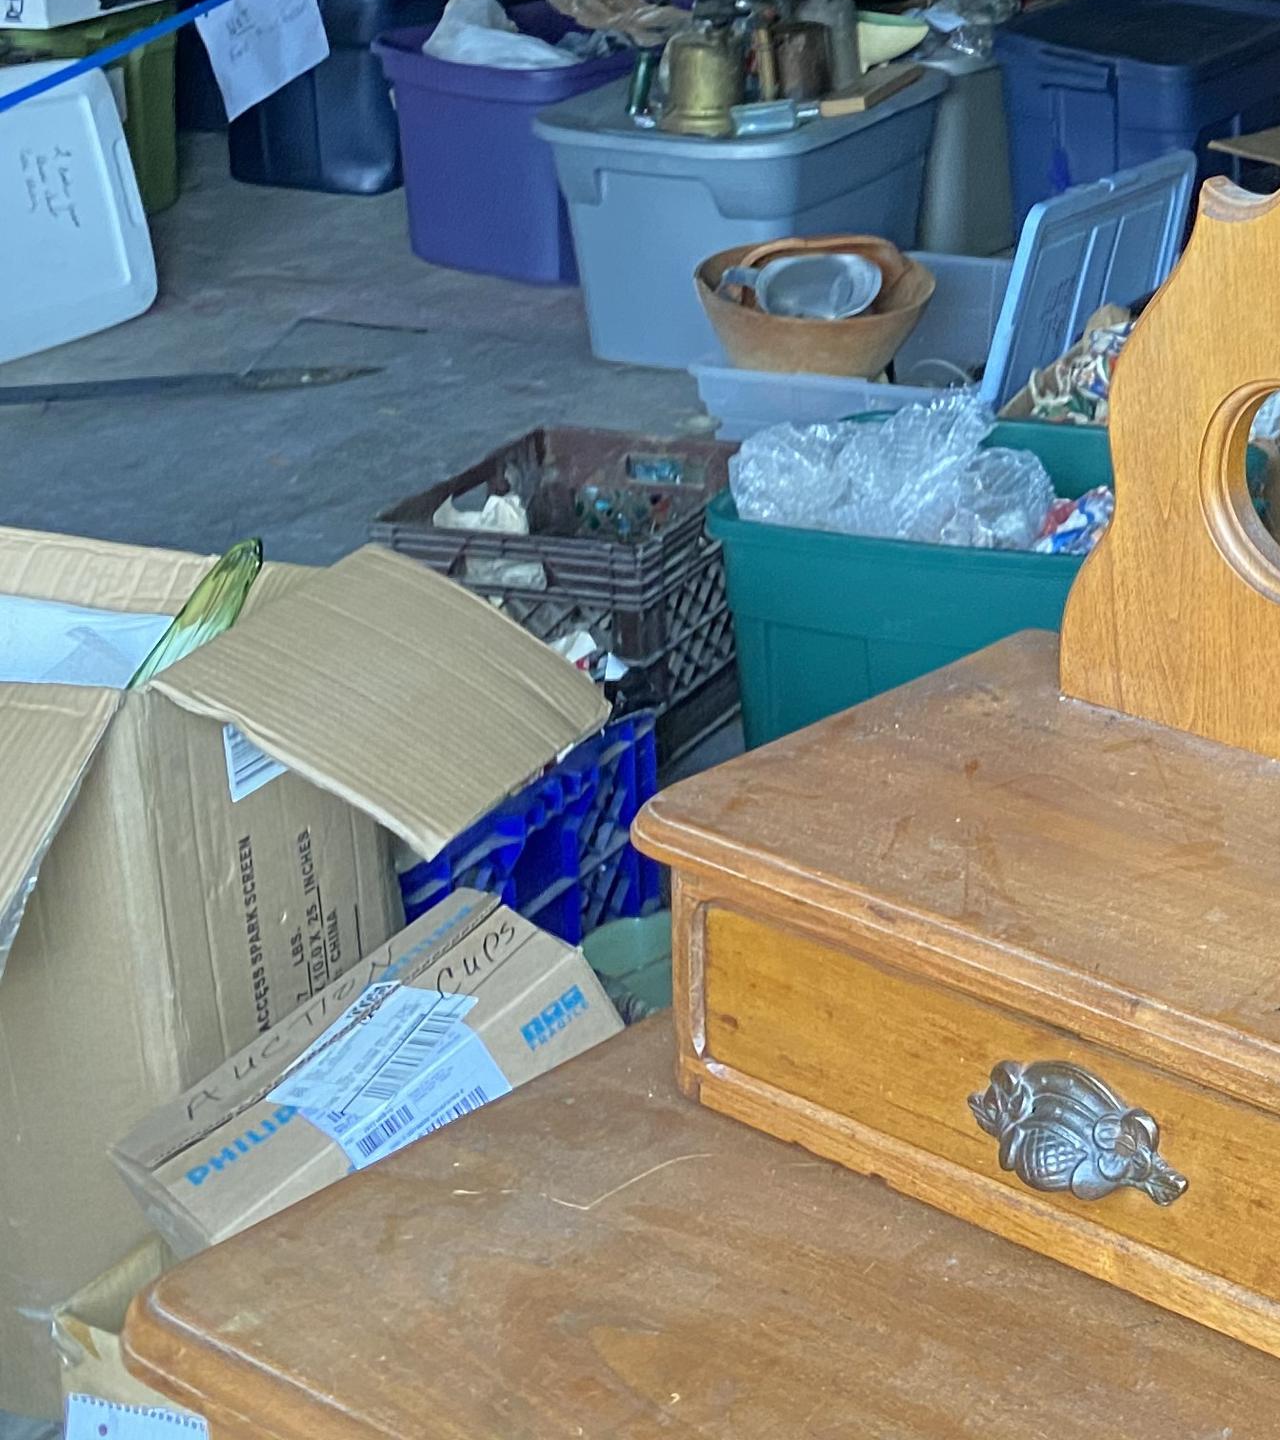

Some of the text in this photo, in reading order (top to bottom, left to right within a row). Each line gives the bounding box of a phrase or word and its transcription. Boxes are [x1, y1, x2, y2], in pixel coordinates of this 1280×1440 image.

[297, 829, 316, 896] INCHES
[237, 834, 272, 1033] ACCESS SPARK SCREEN
[326, 909, 342, 963] CHINA
[185, 1105, 299, 1186] PHILIP
